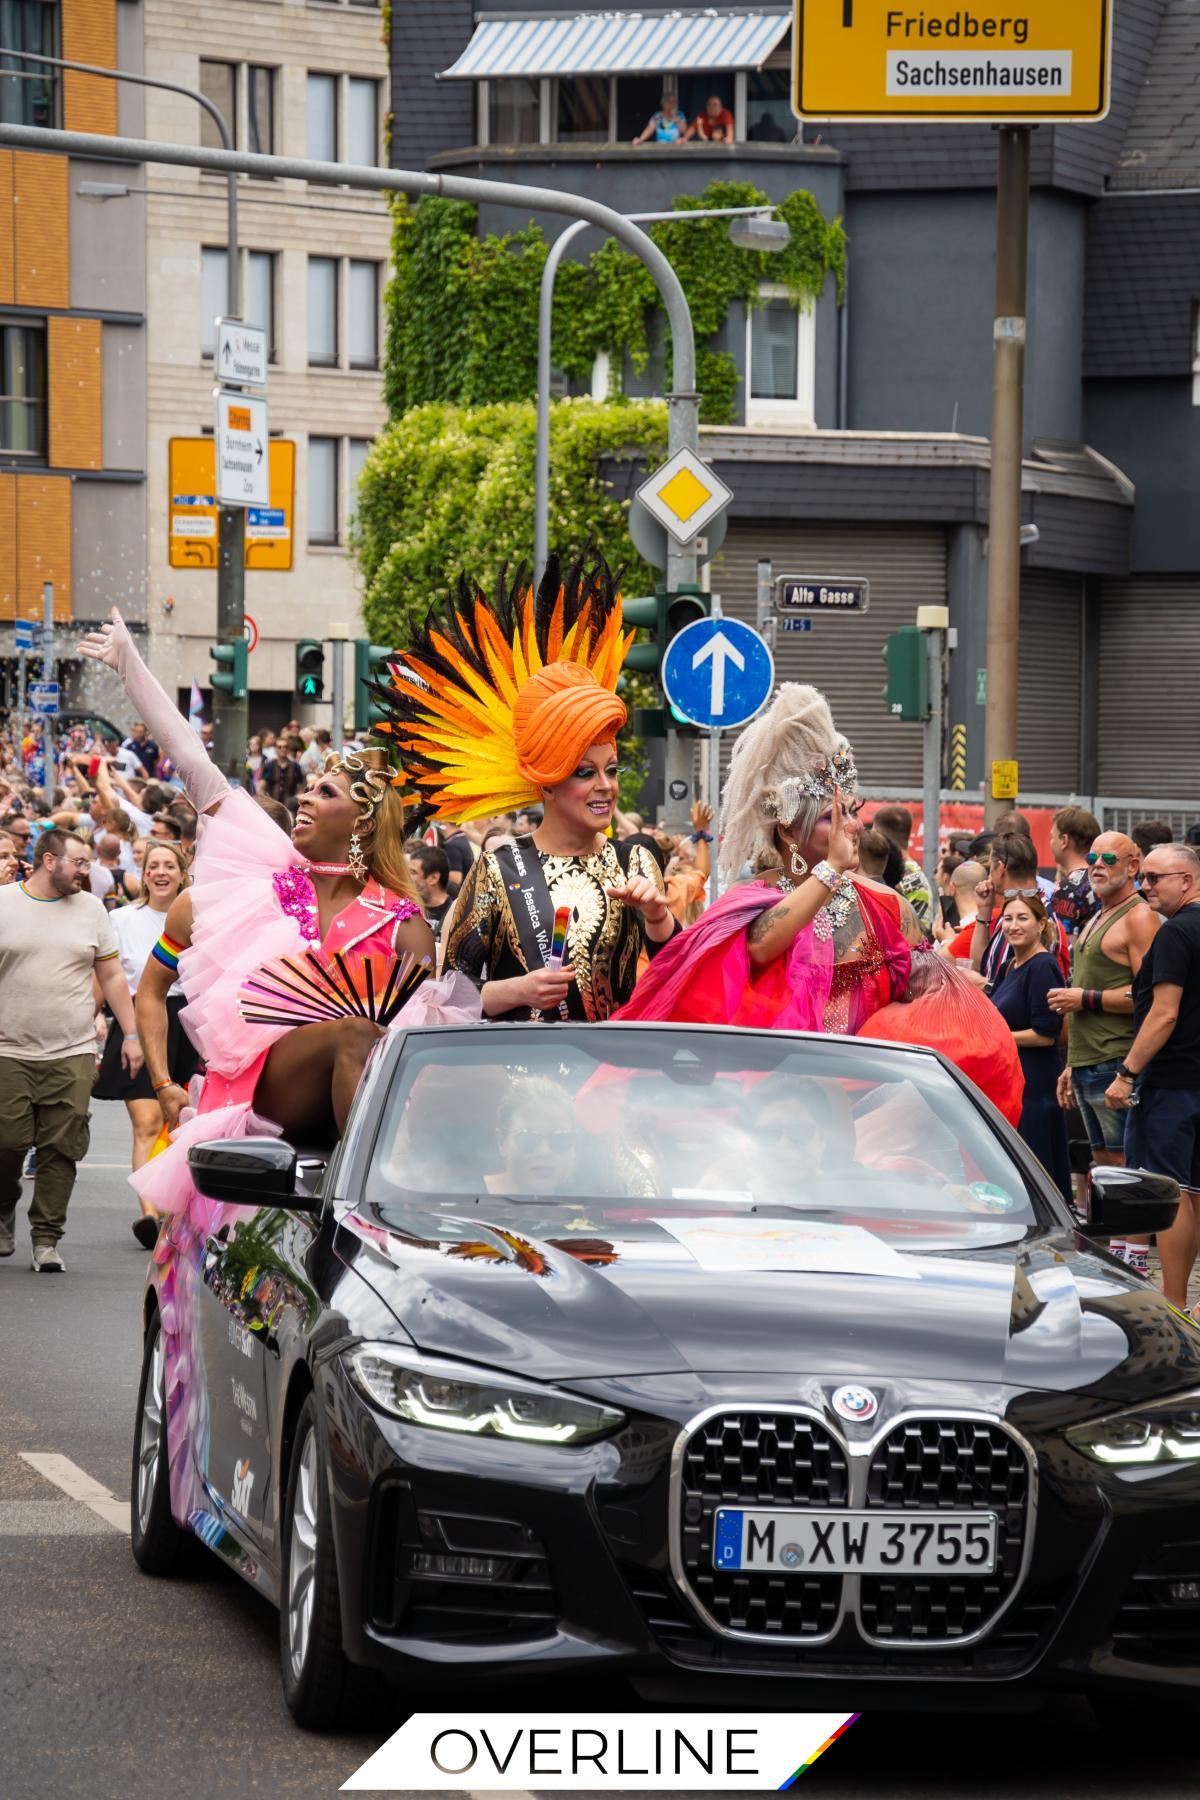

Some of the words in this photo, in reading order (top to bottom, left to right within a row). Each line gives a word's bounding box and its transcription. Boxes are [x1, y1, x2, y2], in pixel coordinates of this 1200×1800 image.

[887, 11, 1029, 44] Friedberg
[896, 60, 1063, 87] Sachsenhausen
[791, 587, 815, 603] Alte
[819, 587, 855, 604] Gasse
[521, 886, 541, 930] Jessica
[536, 929, 552, 968] Walke
[723, 1546, 734, 1560] D
[746, 1519, 776, 1563] M
[808, 1520, 870, 1565] XW
[879, 1522, 991, 1566] 3755
